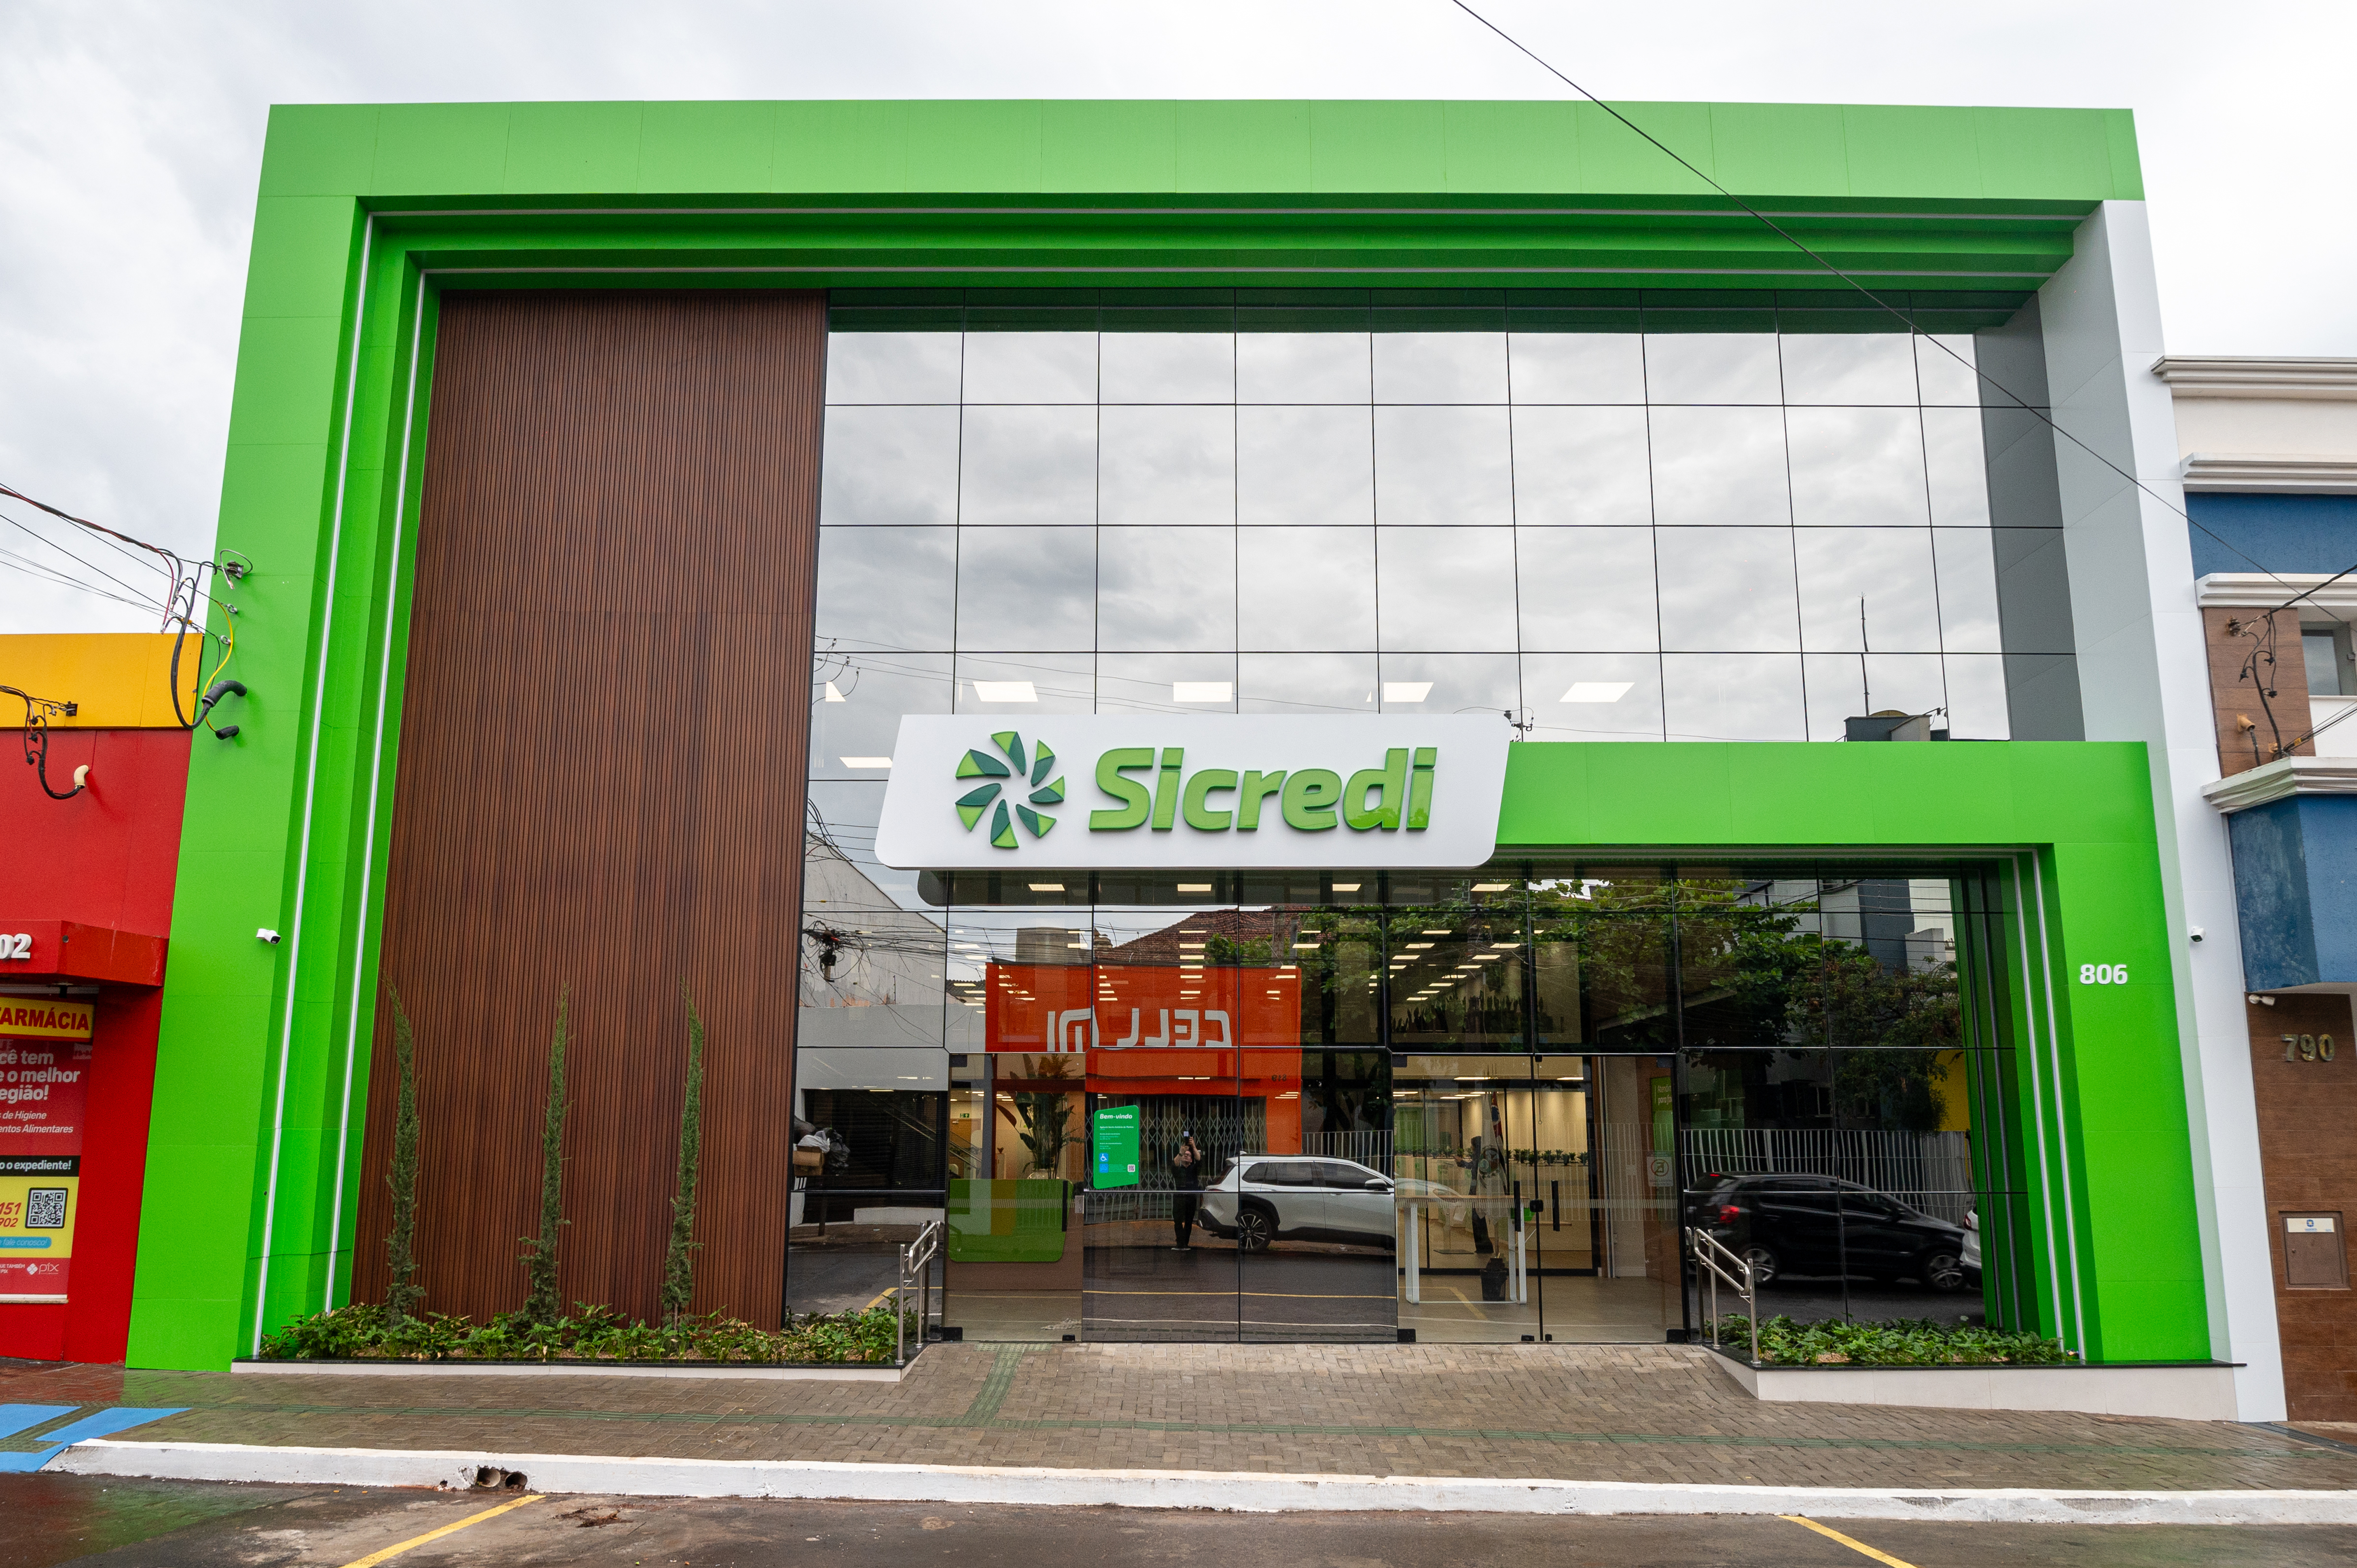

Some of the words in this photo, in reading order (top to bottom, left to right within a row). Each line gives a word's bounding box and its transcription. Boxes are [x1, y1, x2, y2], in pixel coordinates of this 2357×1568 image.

[1089, 747, 1438, 831] Sicredi
[2080, 964, 2128, 984] 806
[0, 1007, 89, 1031] ARMÁCIA
[2281, 1034, 2335, 1061] 790
[21, 1050, 54, 1064] tem
[7, 1071, 18, 1083] o
[21, 1067, 80, 1083] melhor
[2, 1111, 13, 1119] de
[15, 1111, 47, 1121] Higiene
[22, 1124, 74, 1133] Alimentares
[14, 1160, 72, 1172] expediente!
